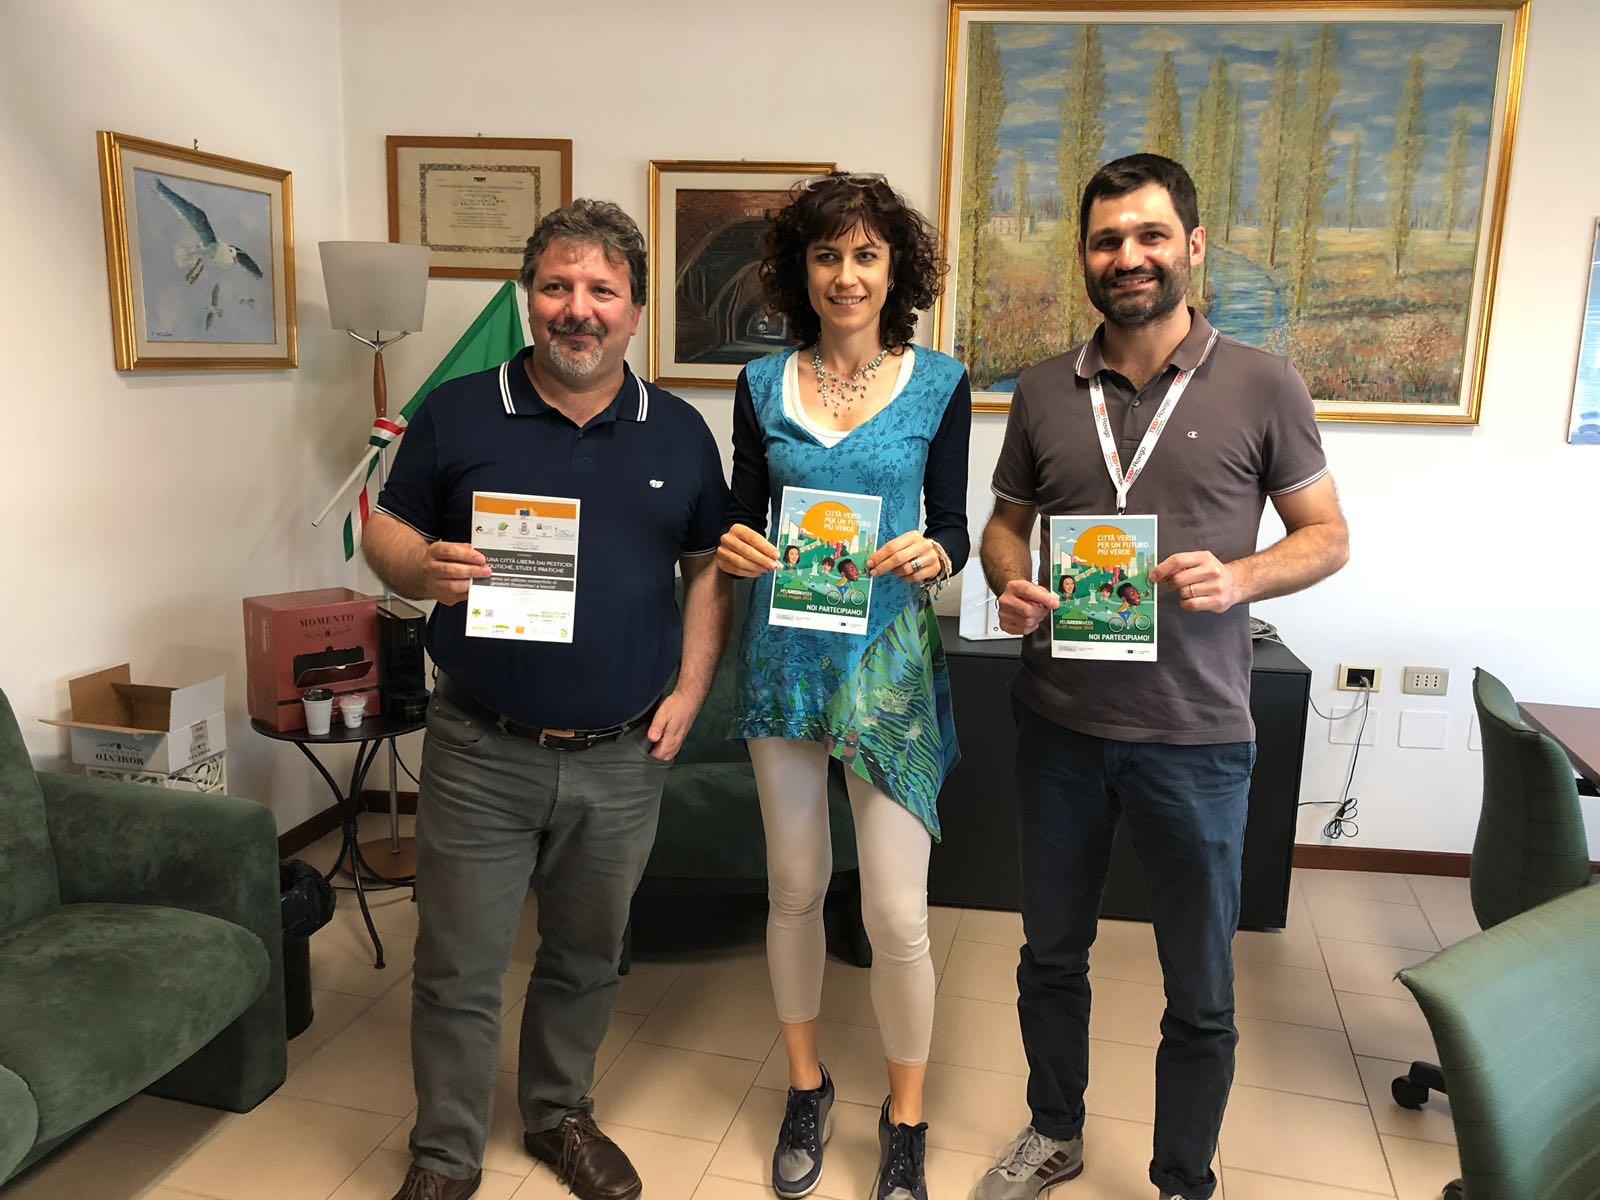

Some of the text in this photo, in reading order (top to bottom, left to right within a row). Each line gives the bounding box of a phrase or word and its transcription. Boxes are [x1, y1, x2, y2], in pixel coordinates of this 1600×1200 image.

[847, 519, 871, 527] FUTURO
[818, 606, 863, 616] PARTECIPIAMO!
[299, 614, 354, 627] MOMENTO
[95, 753, 144, 765] MOMENTO
